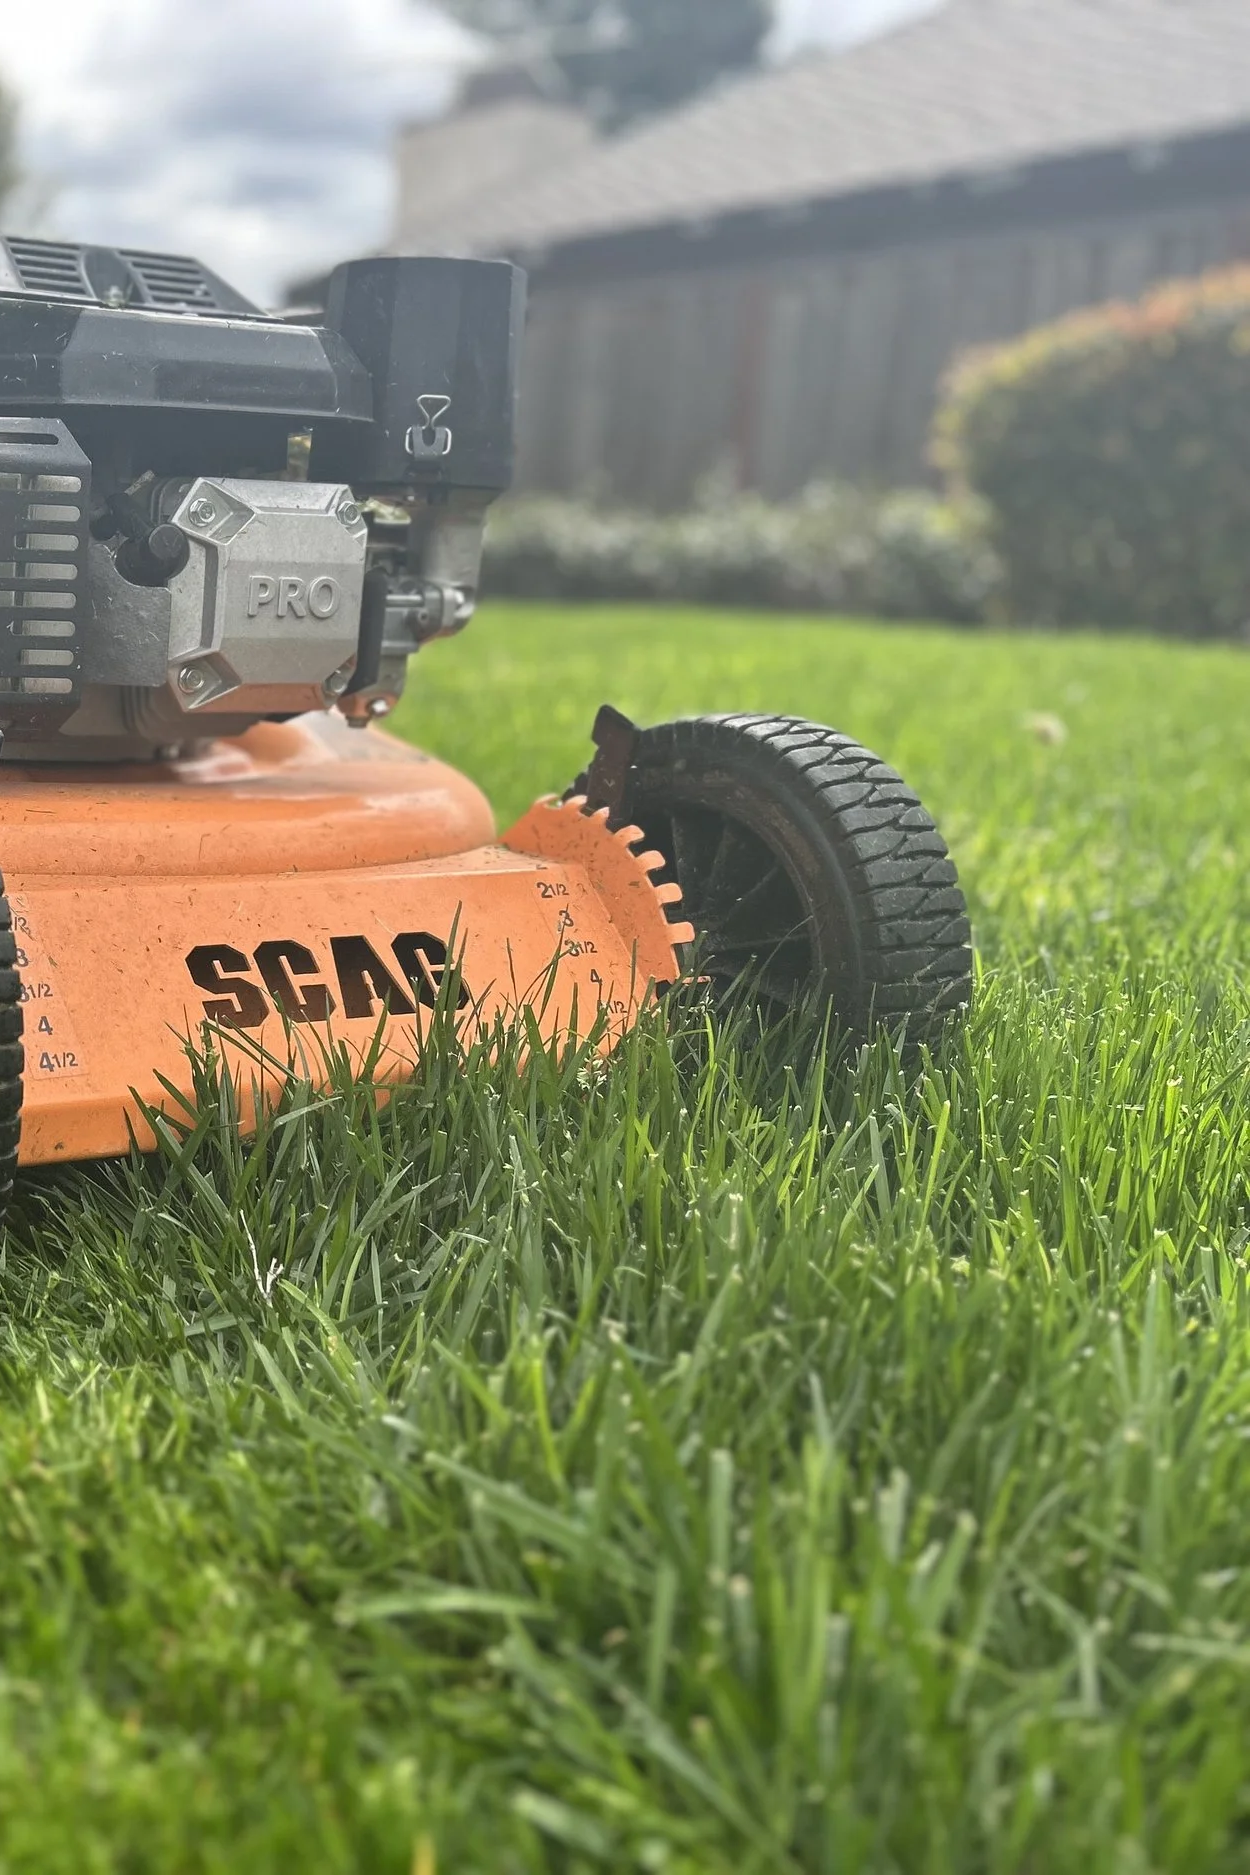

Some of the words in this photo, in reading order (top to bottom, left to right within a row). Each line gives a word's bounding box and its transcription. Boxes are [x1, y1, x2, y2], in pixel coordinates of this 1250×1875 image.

[247, 575, 340, 619] PRO
[558, 910, 574, 927] 3
[185, 931, 470, 1029] SCAG
[38, 1015, 53, 1036] 4
